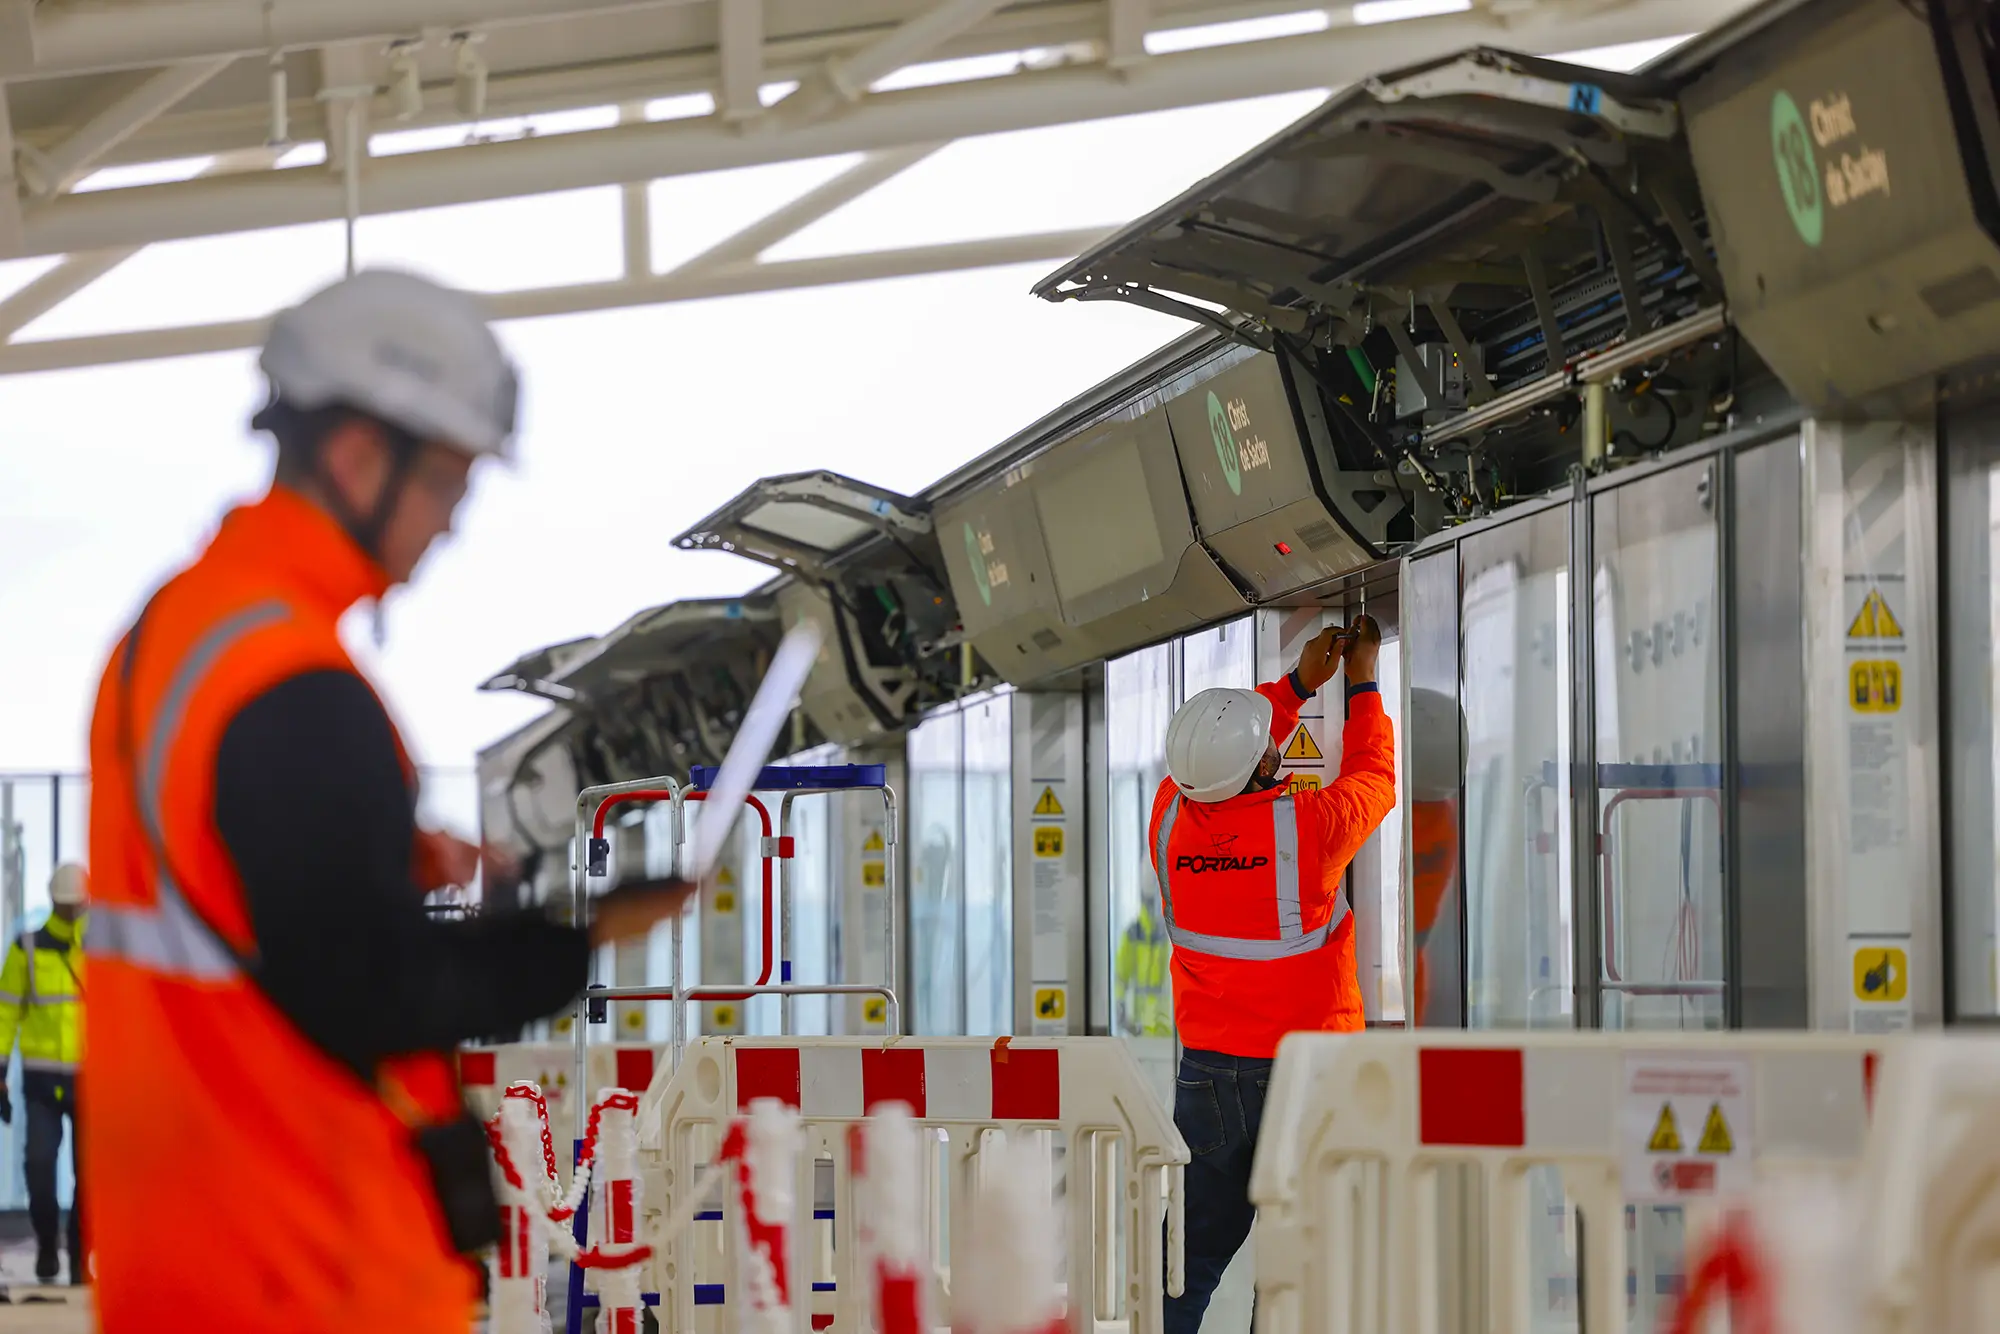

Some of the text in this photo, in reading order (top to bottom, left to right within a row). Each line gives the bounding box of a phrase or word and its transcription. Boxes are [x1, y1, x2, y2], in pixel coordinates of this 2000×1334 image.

[1777, 121, 1815, 213] 18
[1227, 398, 1250, 431] Christ
[1212, 412, 1236, 472] 18
[1239, 434, 1271, 471] de Saclay
[1176, 855, 1268, 874] PORTALP
